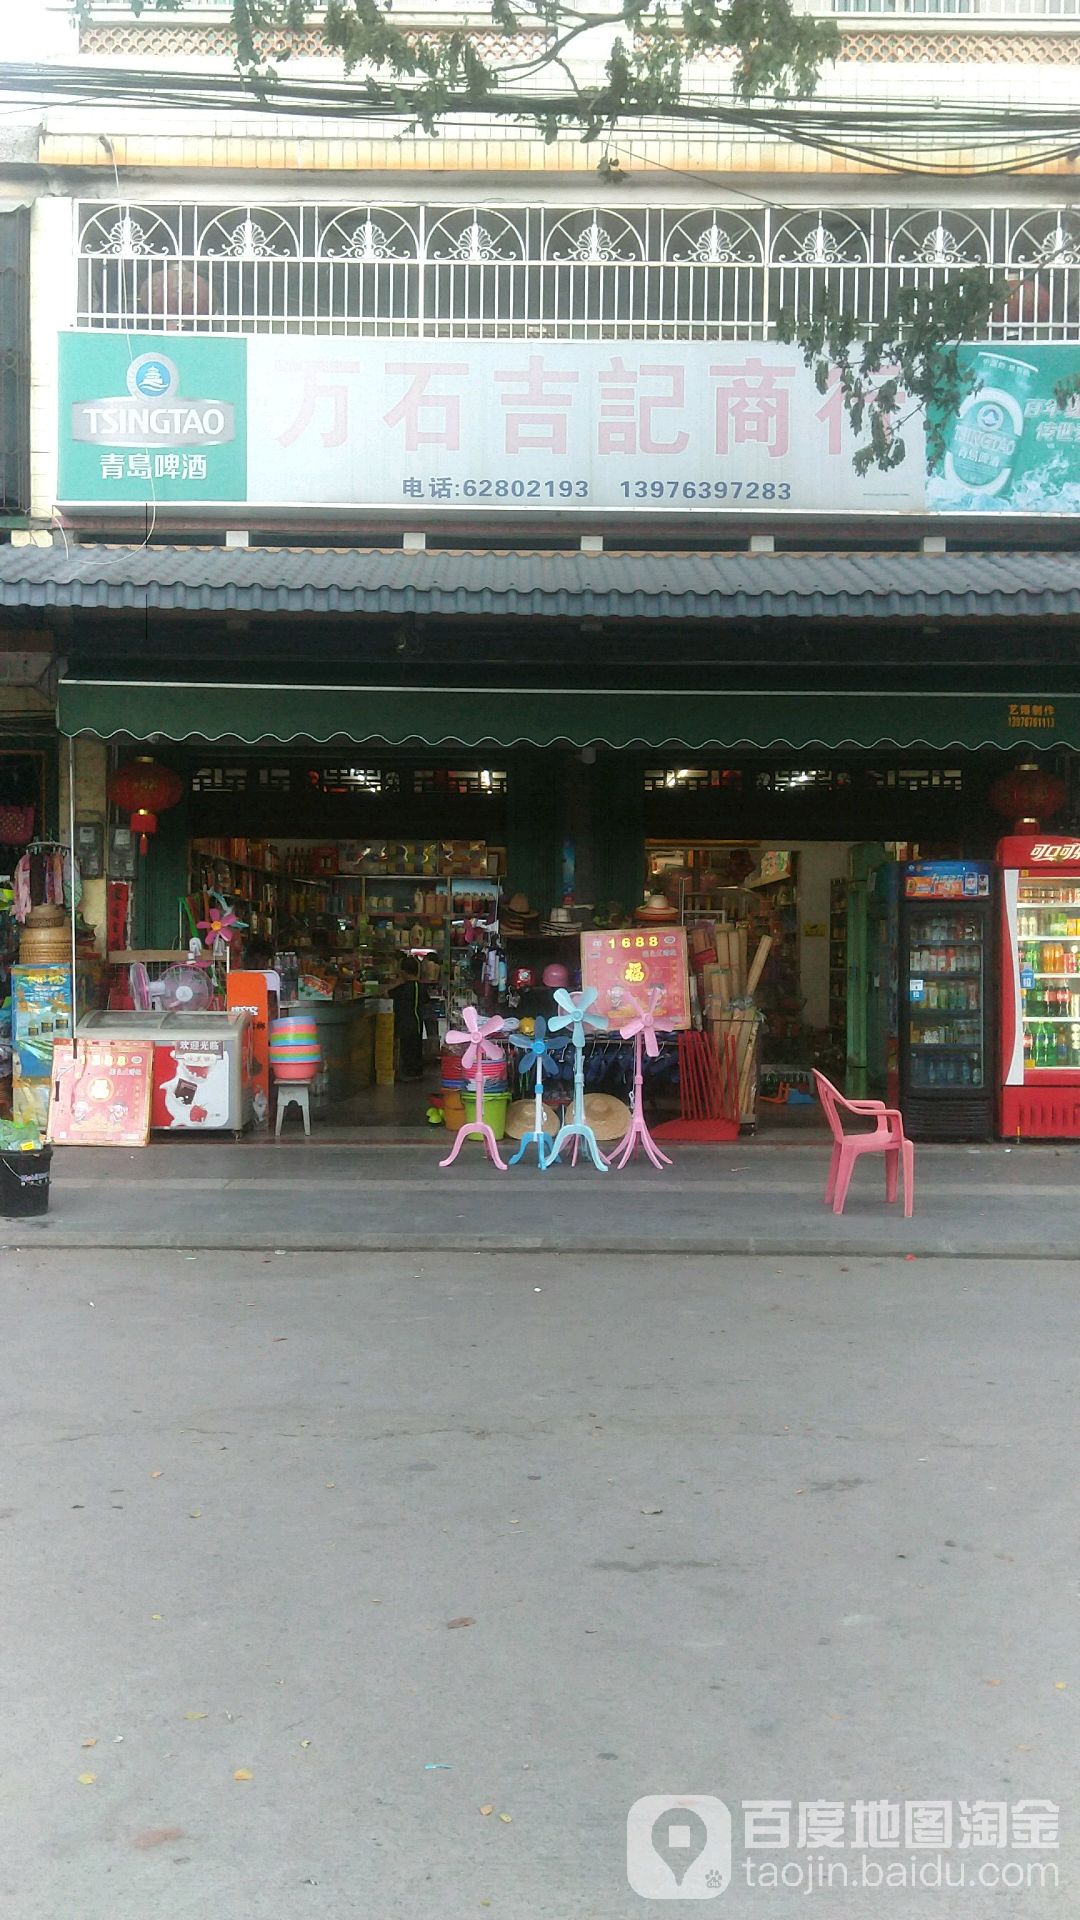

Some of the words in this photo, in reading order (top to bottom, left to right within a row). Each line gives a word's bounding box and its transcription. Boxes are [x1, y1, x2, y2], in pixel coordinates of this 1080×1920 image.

[82, 408, 225, 434] TSINGTAO
[620, 480, 791, 500] 13976397283
[608, 936, 659, 949] 1688
